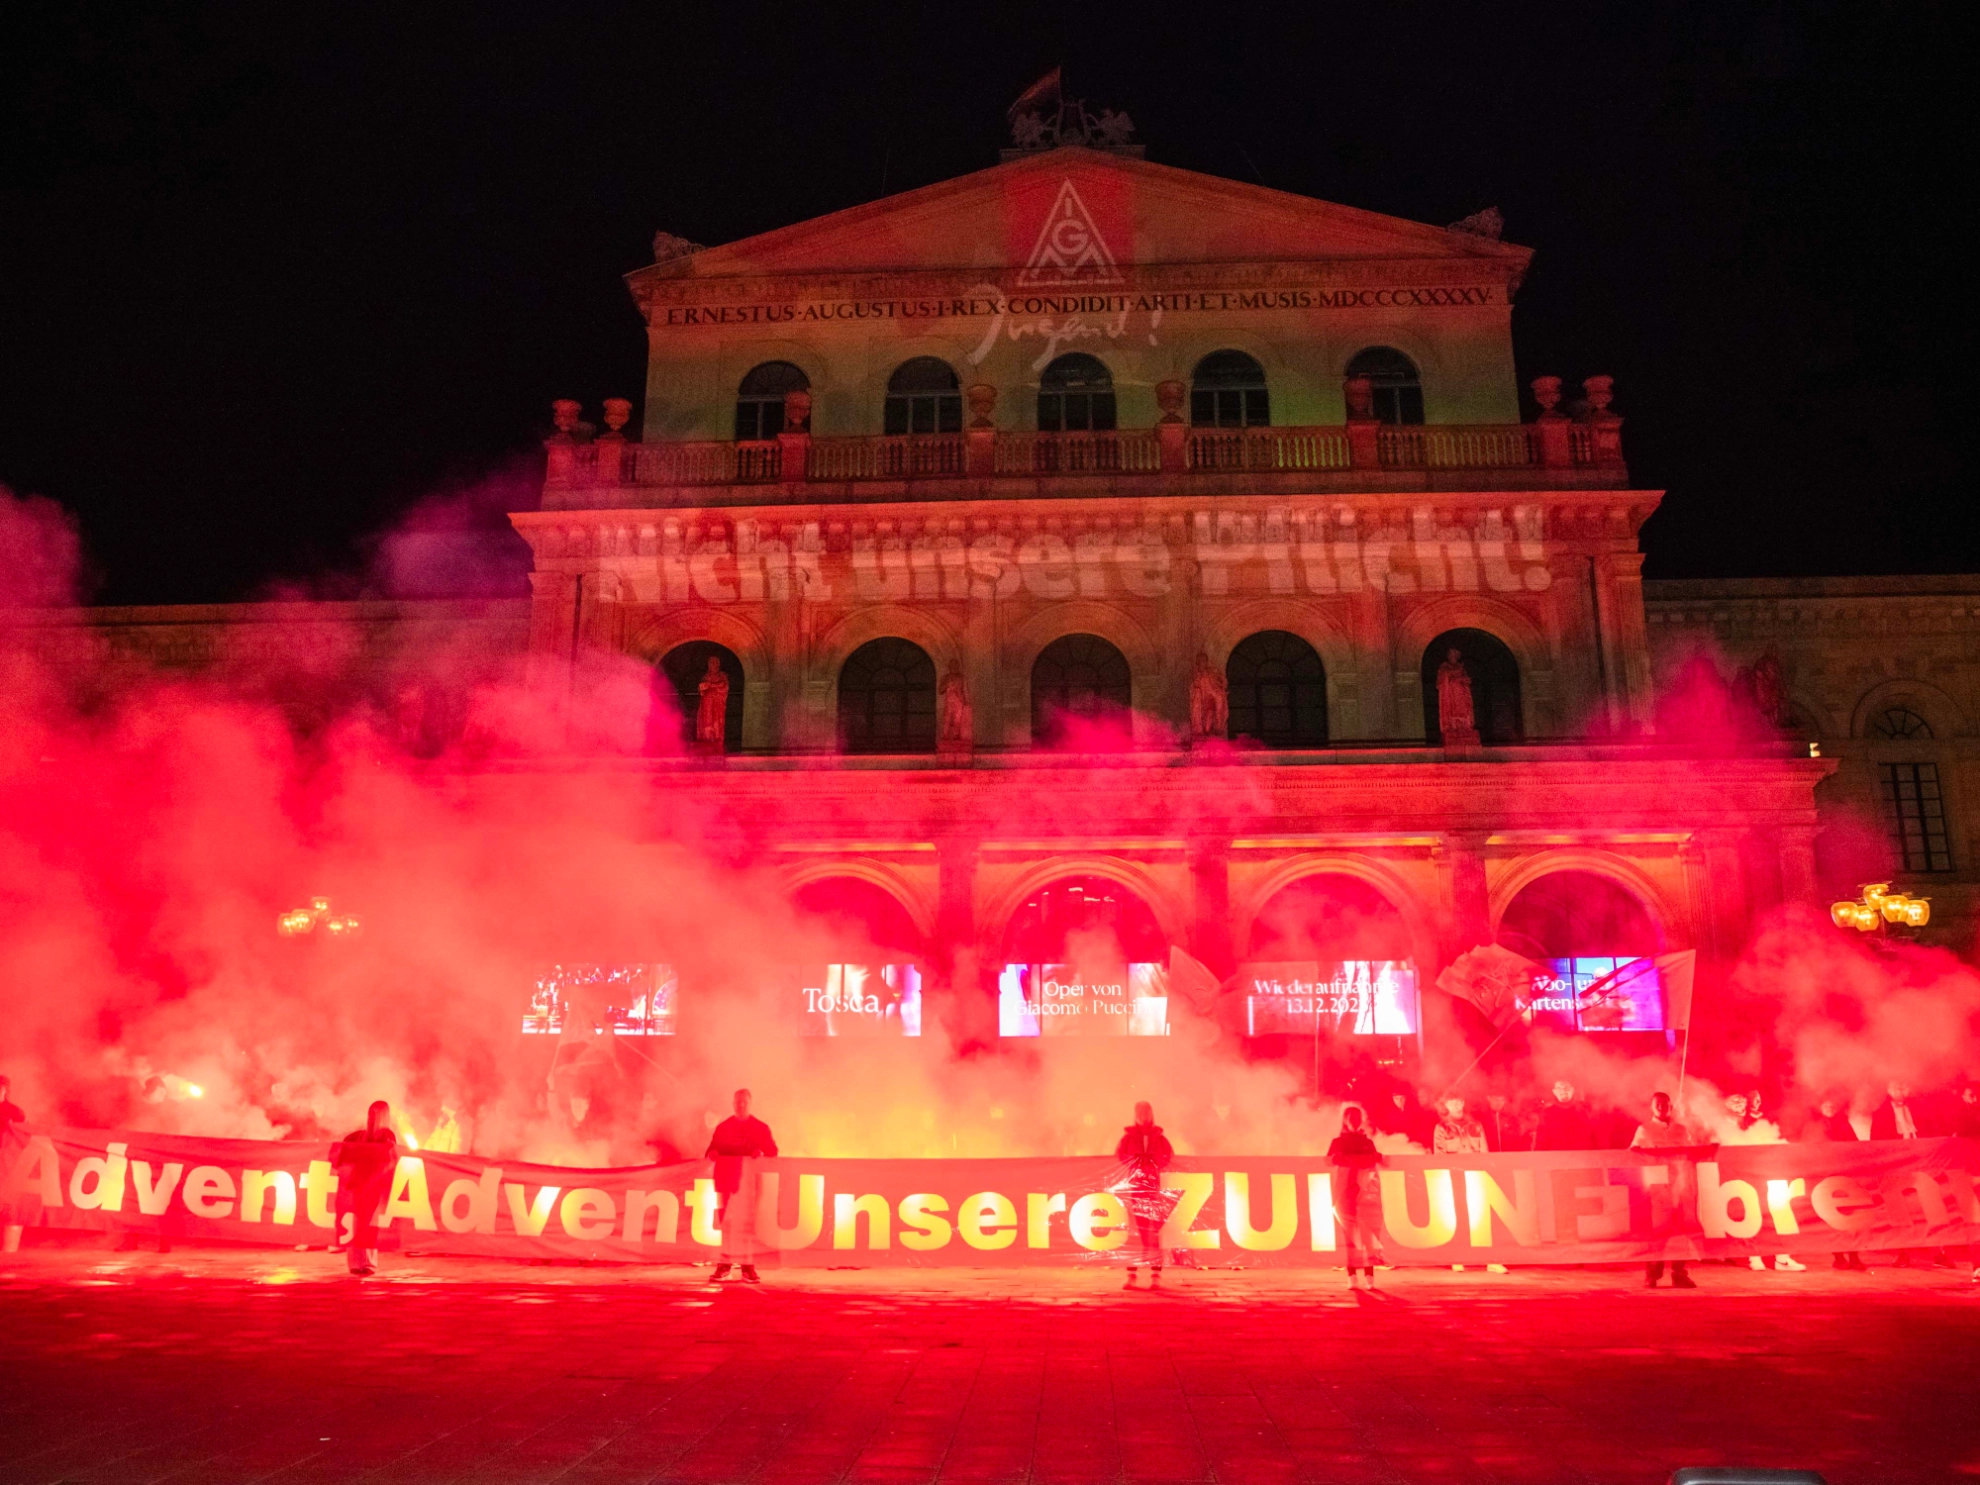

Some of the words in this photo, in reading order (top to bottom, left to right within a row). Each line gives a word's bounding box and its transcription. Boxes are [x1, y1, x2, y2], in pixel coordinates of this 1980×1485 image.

[801, 301, 931, 321] AUGUSTUS
[952, 299, 1001, 315] REX
[1007, 297, 1127, 313] CONDIDIT
[1138, 294, 1191, 311] ARTI
[1200, 292, 1231, 309] ET
[1239, 291, 1312, 308] MUSIS
[851, 530, 1173, 600] unsere
[802, 987, 879, 1013] Tosca
[1044, 980, 1088, 999] Oper
[1092, 984, 1122, 996] von
[1287, 997, 1366, 1014] 13.12.202
[10, 1135, 354, 1245] Advent,
[377, 1155, 722, 1247] Advent
[755, 1172, 1130, 1251] Unsere
